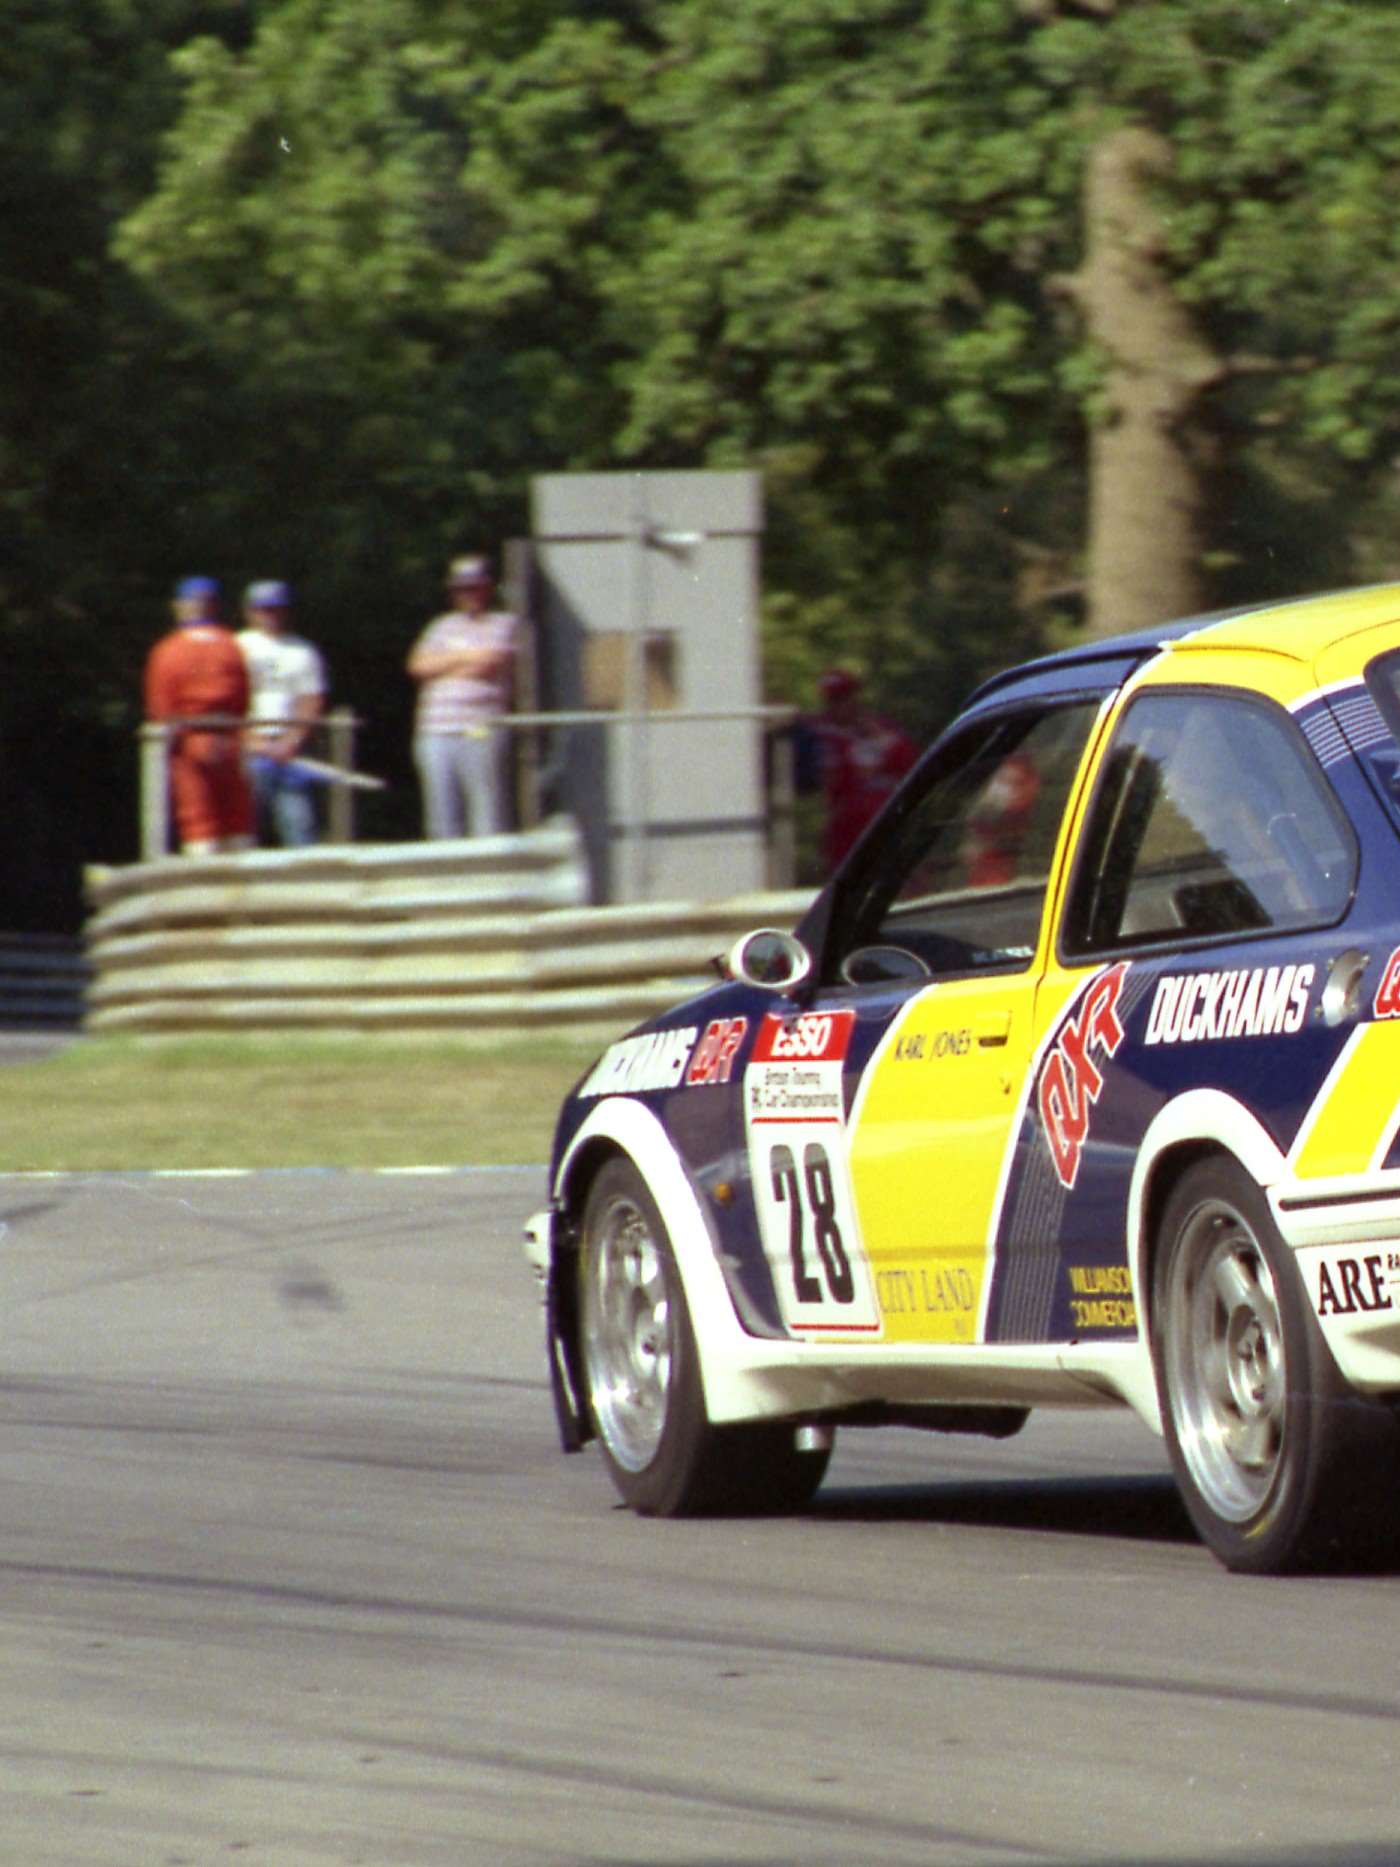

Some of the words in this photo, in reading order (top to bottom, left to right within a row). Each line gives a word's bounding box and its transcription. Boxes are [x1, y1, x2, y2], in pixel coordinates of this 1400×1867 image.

[1144, 963, 1316, 1045] DUCKHAMS
[894, 1034, 926, 1061] KARL
[929, 1029, 972, 1061] JONES
[1038, 961, 1133, 1190] QXR
[768, 1141, 856, 1305] 28
[877, 1269, 918, 1313] CITY
[920, 1268, 975, 1311] LAND
[1069, 1266, 1133, 1294] WILLIAMSO
[1318, 1254, 1392, 1316] ARE
